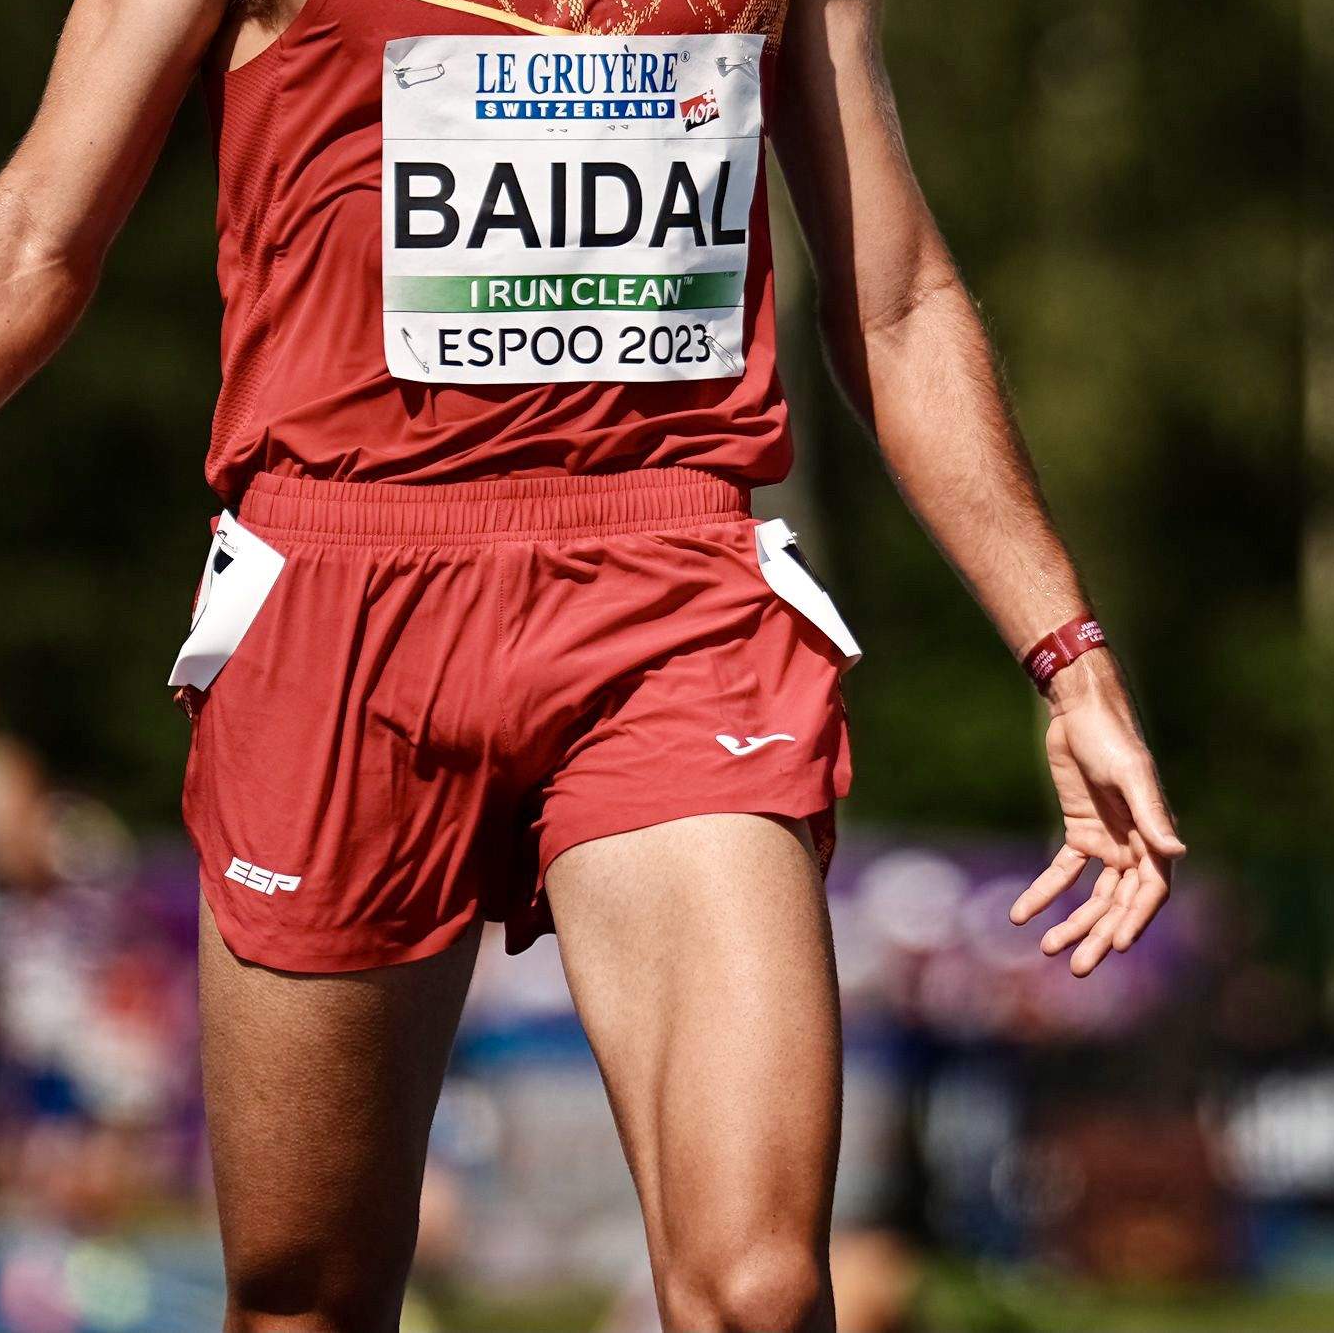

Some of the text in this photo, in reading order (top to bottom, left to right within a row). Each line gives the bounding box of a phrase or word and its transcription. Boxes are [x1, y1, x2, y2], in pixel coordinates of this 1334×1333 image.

[476, 53, 516, 94] LE
[484, 101, 669, 117] SWITZERLAND
[683, 101, 718, 126] AOP
[394, 161, 746, 249] BAIDAL
[469, 280, 479, 308] I
[488, 278, 563, 308] RUN
[438, 323, 711, 367] ESPOO 2023
[224, 856, 302, 896] ESP
